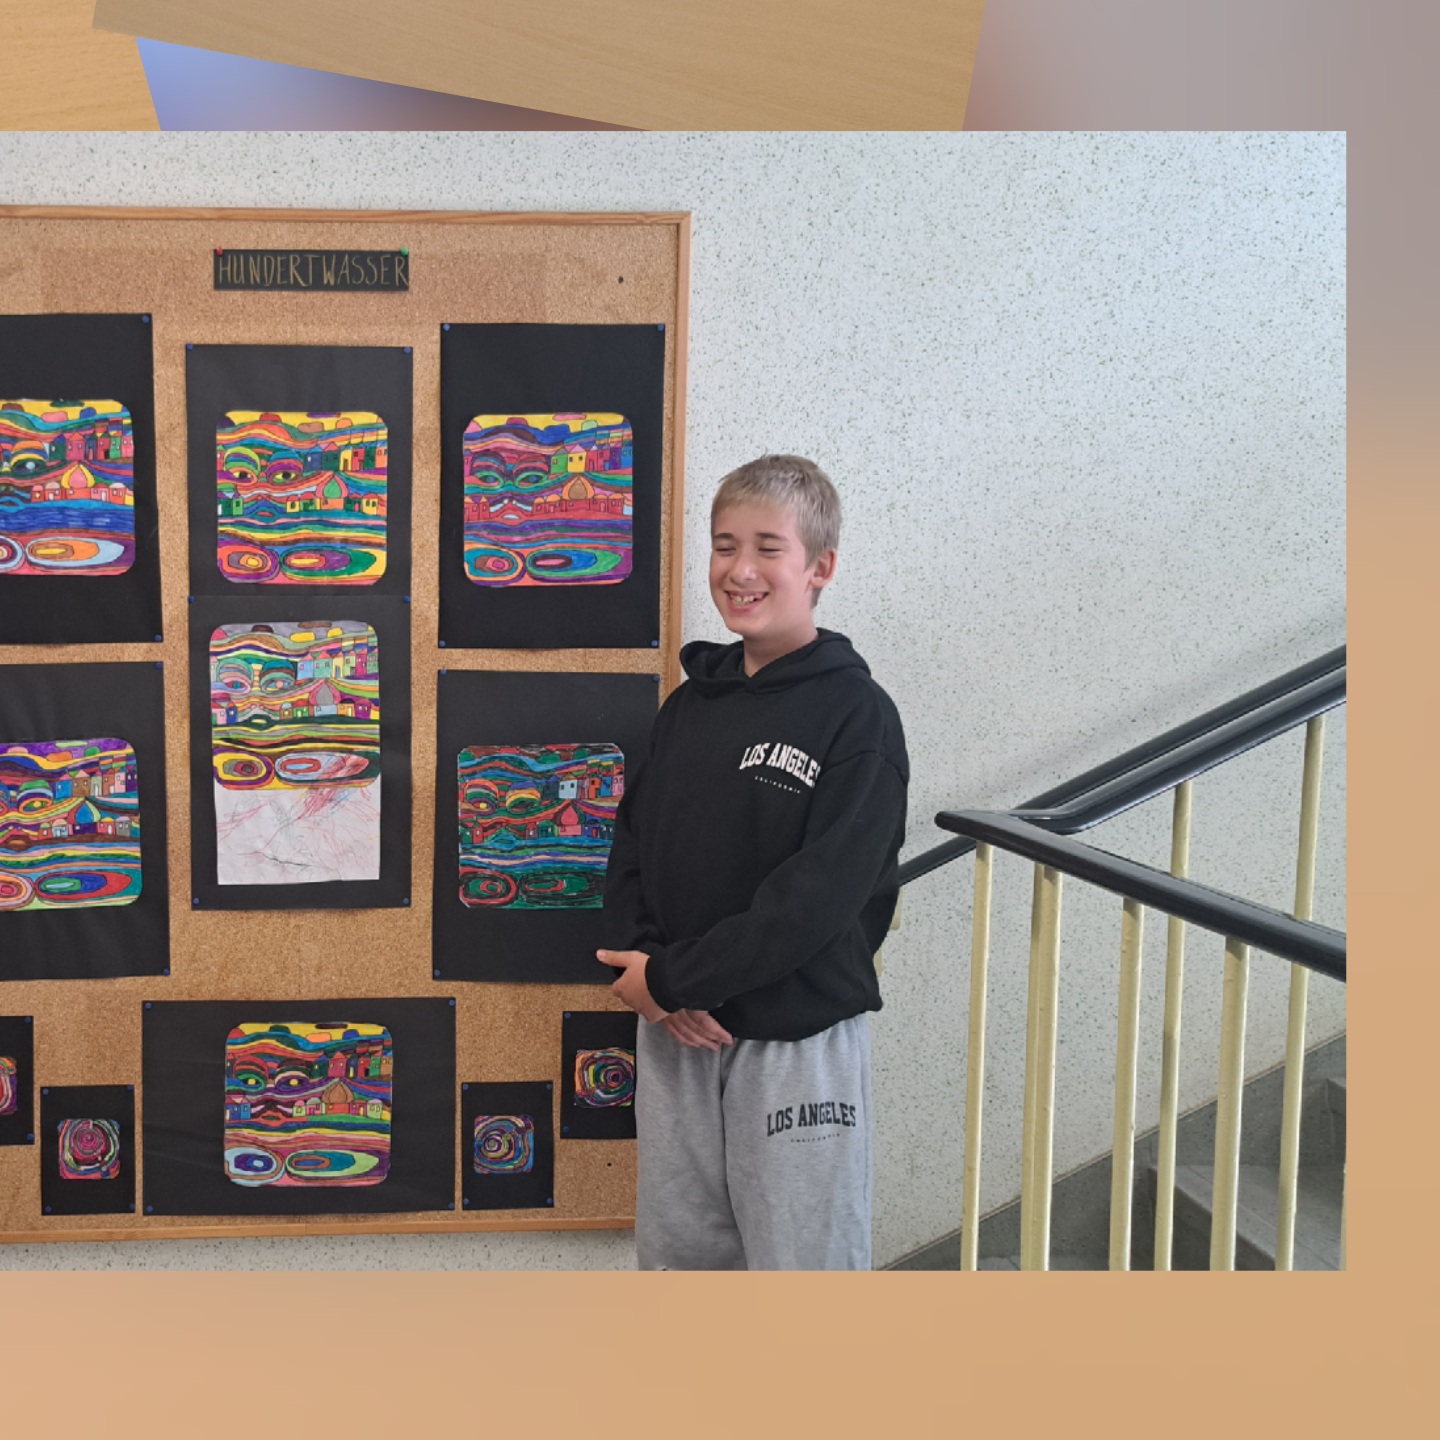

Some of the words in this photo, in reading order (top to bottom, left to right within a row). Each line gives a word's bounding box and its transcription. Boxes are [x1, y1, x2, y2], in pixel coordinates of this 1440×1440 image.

[738, 742, 771, 770] LOS
[766, 1106, 794, 1137] LOS
[798, 1101, 857, 1127] ANGELES
